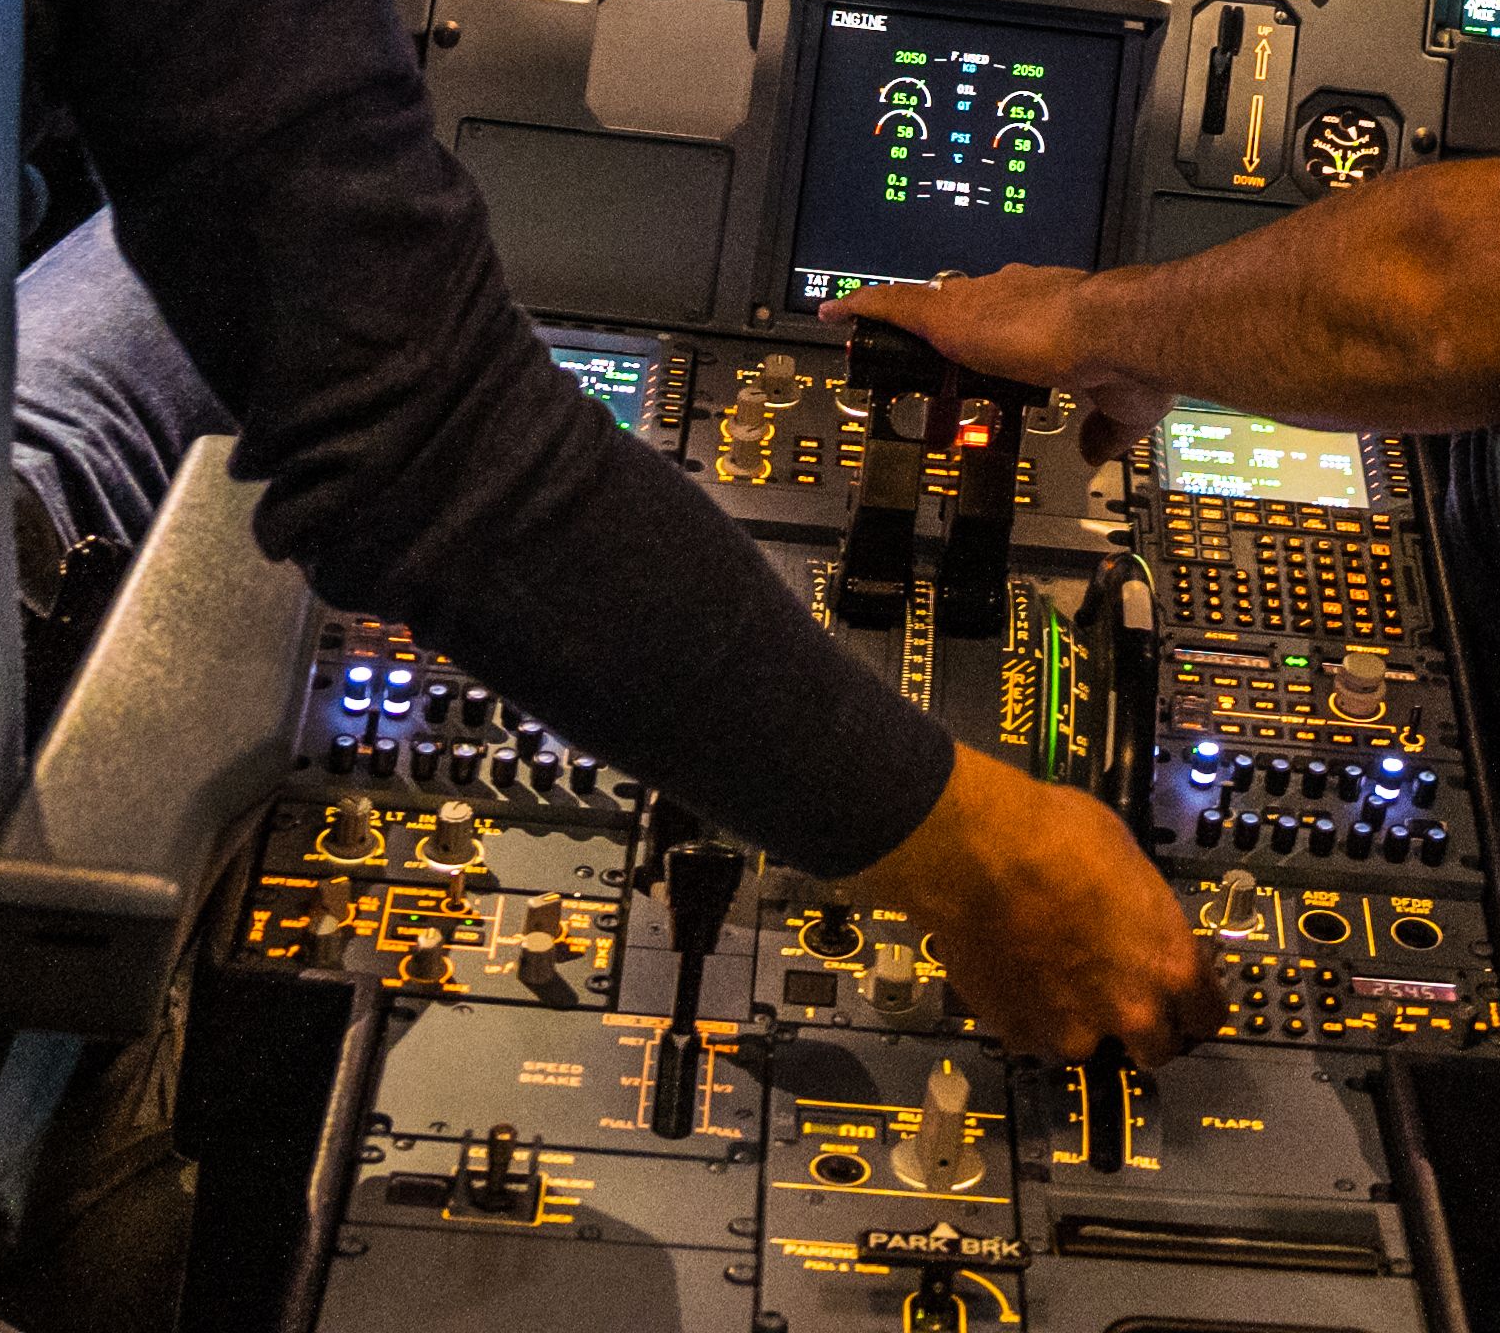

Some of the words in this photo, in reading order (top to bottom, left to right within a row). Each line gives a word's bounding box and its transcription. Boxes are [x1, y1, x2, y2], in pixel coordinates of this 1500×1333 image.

[831, 10, 887, 31] ENGINE
[1257, 26, 1272, 36] UP
[895, 51, 927, 65] 2050
[1012, 64, 1044, 77] 2050
[892, 93, 918, 106] 15.0
[1009, 107, 1035, 119] 15.0
[897, 126, 913, 138] 58
[951, 133, 971, 143] PSI
[1014, 139, 1031, 151] 58
[890, 147, 908, 159] 60
[1008, 160, 1025, 172] 60
[888, 175, 908, 187] 0.3
[1234, 174, 1265, 187] DOWN
[885, 189, 906, 201] 0.5
[1003, 201, 1024, 213] 0.5
[808, 274, 830, 286] TAT
[837, 278, 861, 289] +20
[805, 286, 828, 297] SAT
[1017, 597, 1029, 641] A/THR
[1014, 673, 1026, 714] REV
[1001, 733, 1028, 744] FULL
[419, 815, 436, 823] IN
[1303, 891, 1339, 902] AIDS
[1391, 897, 1433, 909] DFDR
[872, 909, 907, 921] ENG
[249, 911, 271, 941] WXR
[594, 938, 612, 968] WXR
[963, 1019, 975, 1031] 2
[523, 1061, 584, 1074] SPEED
[519, 1073, 581, 1086] BRAKE
[600, 1118, 634, 1129] FULL
[1202, 1117, 1264, 1131] FLAPS
[707, 1126, 742, 1138] FULL
[869, 1232, 947, 1253] PARK
[961, 1238, 1022, 1258] BRK
